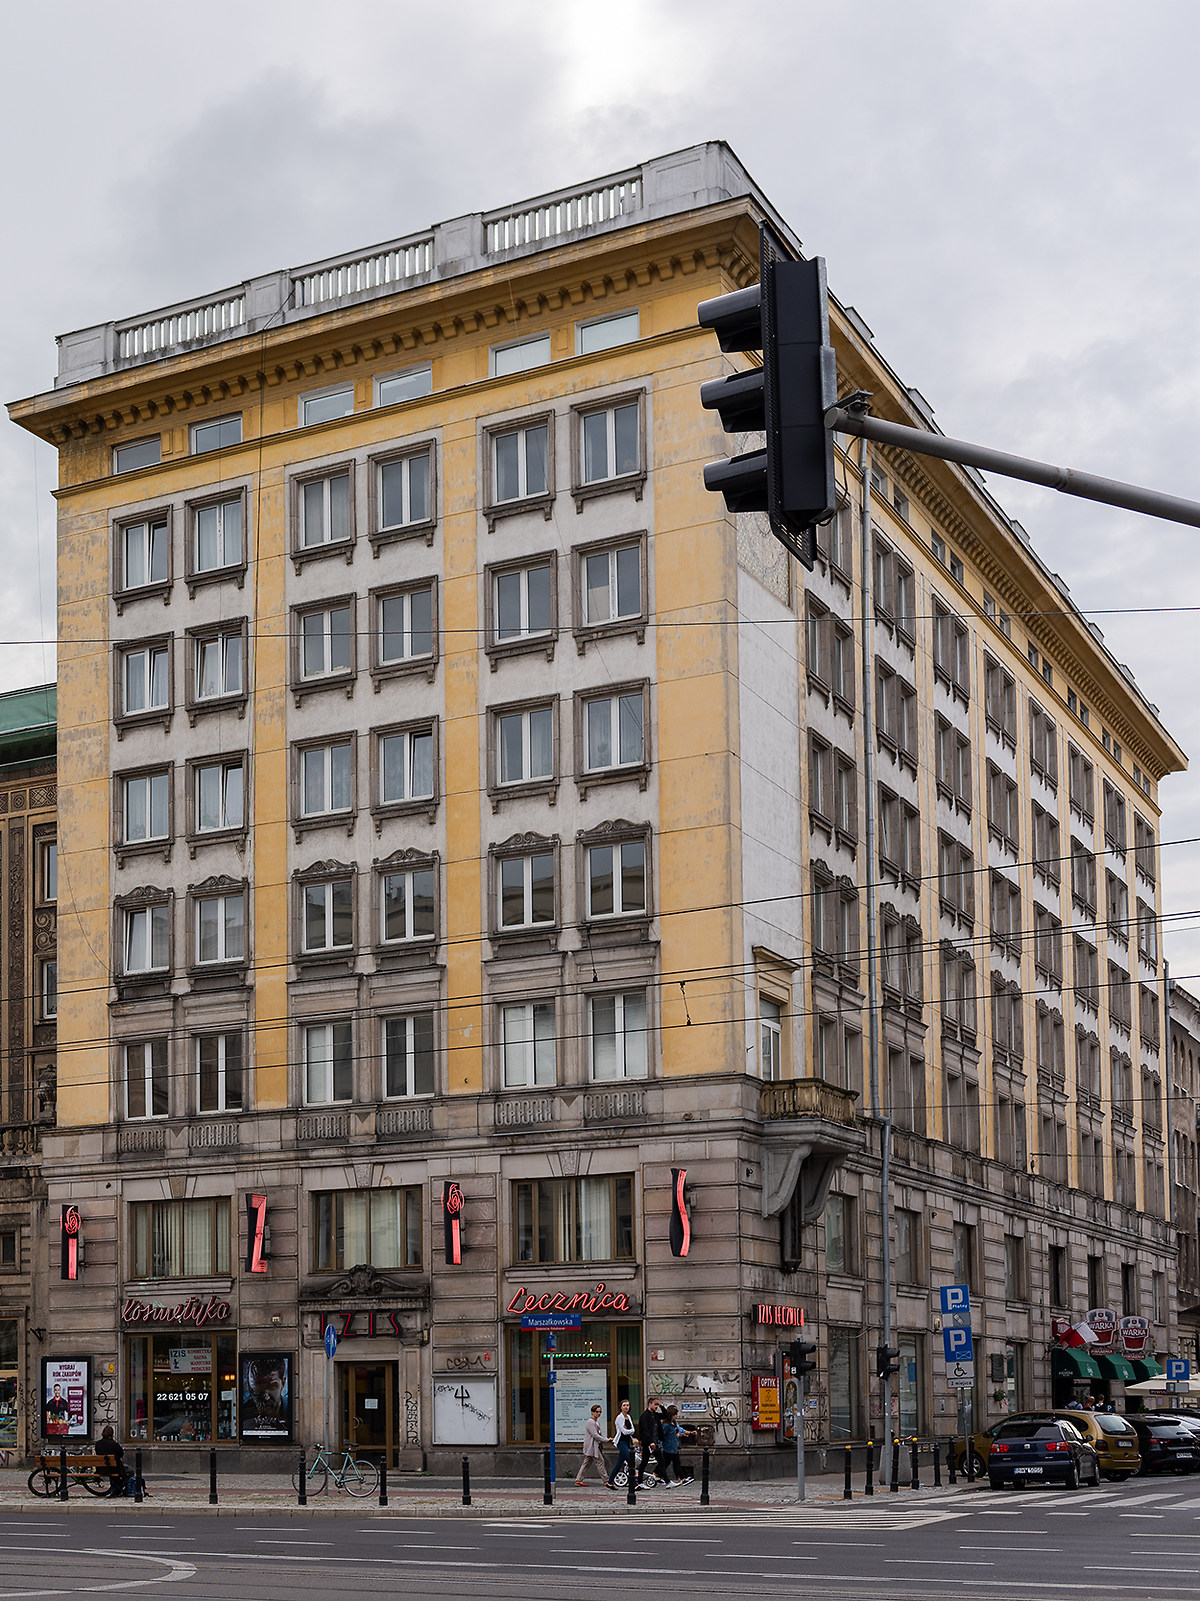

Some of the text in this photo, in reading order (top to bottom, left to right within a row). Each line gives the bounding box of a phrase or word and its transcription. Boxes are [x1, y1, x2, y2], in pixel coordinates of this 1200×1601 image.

[507, 1282, 631, 1313] Lecznica
[947, 1288, 963, 1310] P
[949, 1329, 966, 1351] P
[1172, 1361, 1185, 1377] P
[761, 1378, 776, 1387] OPTYK
